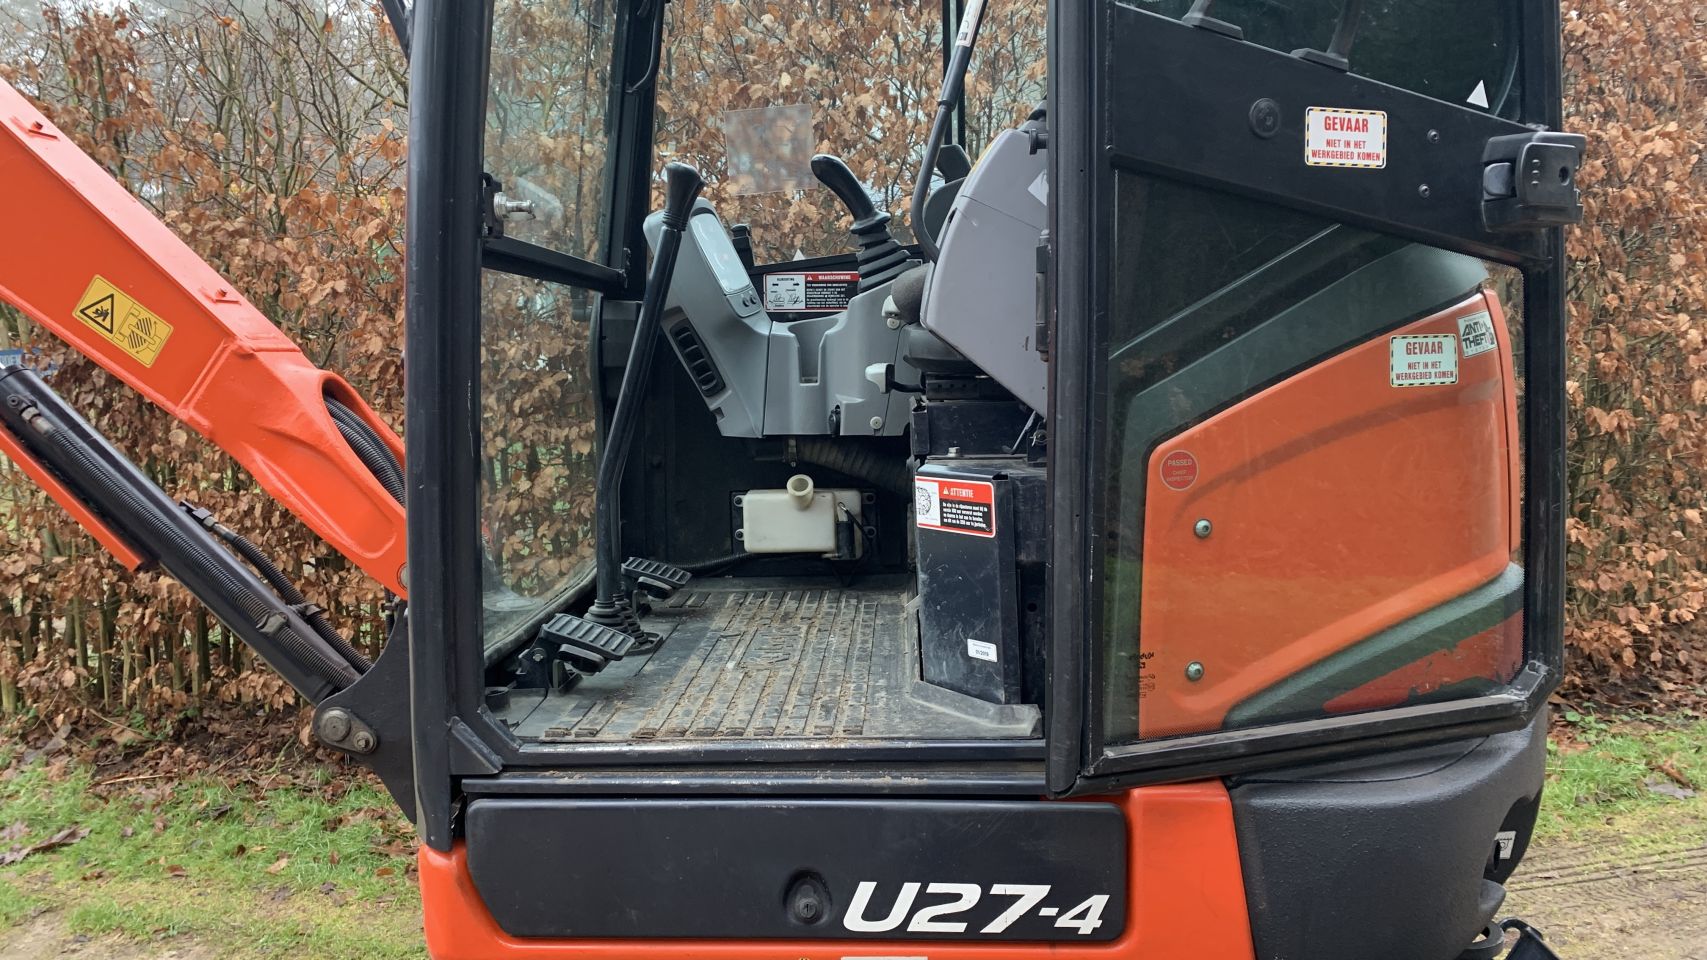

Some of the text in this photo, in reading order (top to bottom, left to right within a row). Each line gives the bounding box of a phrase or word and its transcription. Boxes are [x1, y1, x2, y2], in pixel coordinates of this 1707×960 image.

[1324, 116, 1369, 132] GEVAAR
[1326, 139, 1366, 149] NIET IN HET
[1311, 150, 1380, 161] WERKGEBIED KOMEN
[1406, 341, 1443, 355] GEVAAR
[1408, 362, 1420, 370] NIET
[1431, 361, 1442, 369] HET
[1395, 371, 1453, 380] WERKGEBIED KOMEN
[950, 488, 974, 498] ATTENTIE
[843, 881, 1110, 935] U27-4
